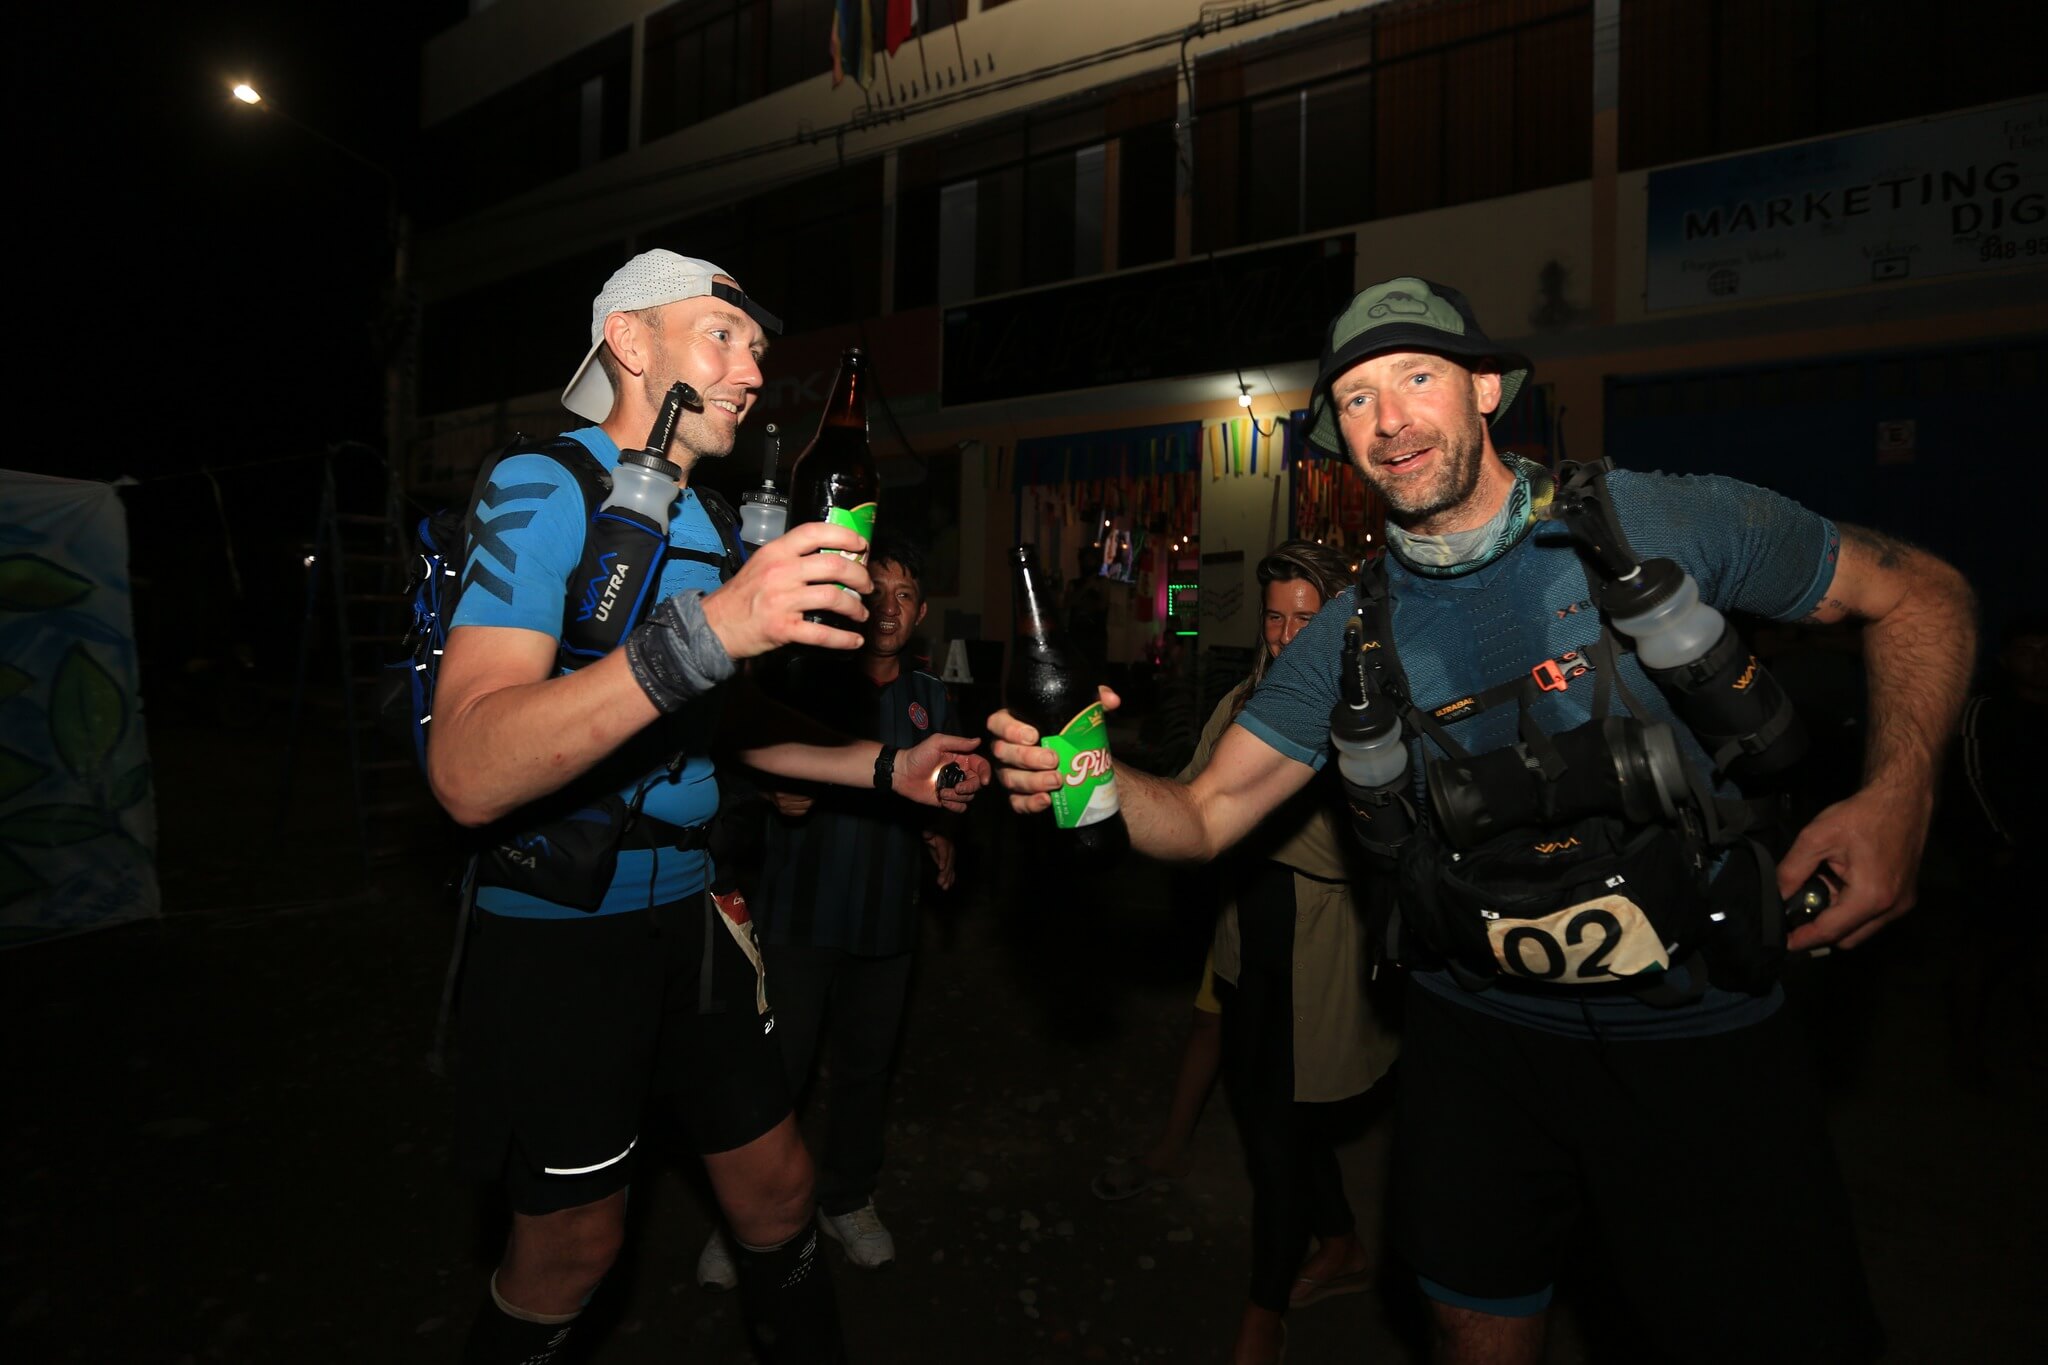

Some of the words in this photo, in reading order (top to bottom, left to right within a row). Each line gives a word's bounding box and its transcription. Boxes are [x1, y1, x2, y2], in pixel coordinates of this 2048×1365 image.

[1685, 161, 2021, 241] MARKETING
[1951, 193, 2047, 235] DIG
[595, 563, 630, 622] ULTRA
[1503, 908, 1623, 980] 02
